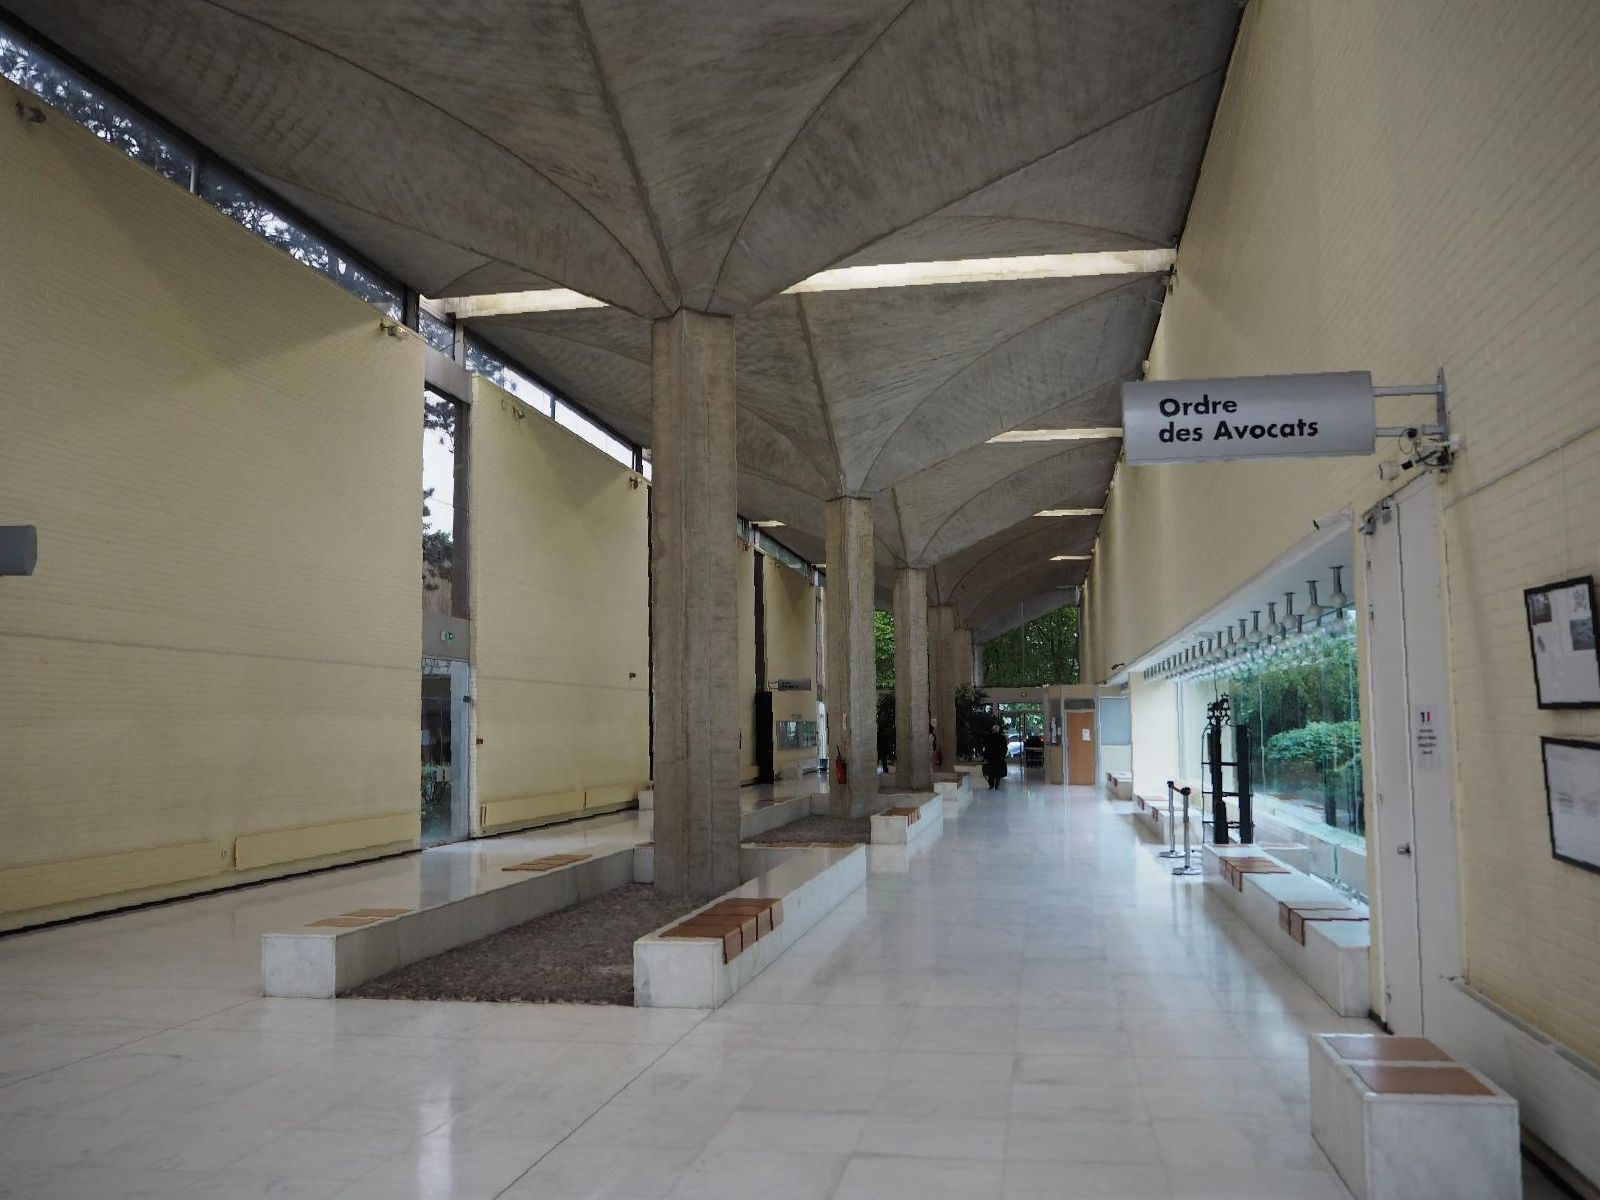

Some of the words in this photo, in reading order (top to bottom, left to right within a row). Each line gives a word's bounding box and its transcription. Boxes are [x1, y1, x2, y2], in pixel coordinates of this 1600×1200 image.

[1159, 394, 1237, 418] Ordre
[1158, 422, 1203, 443] des
[1213, 419, 1319, 441] Avocats
